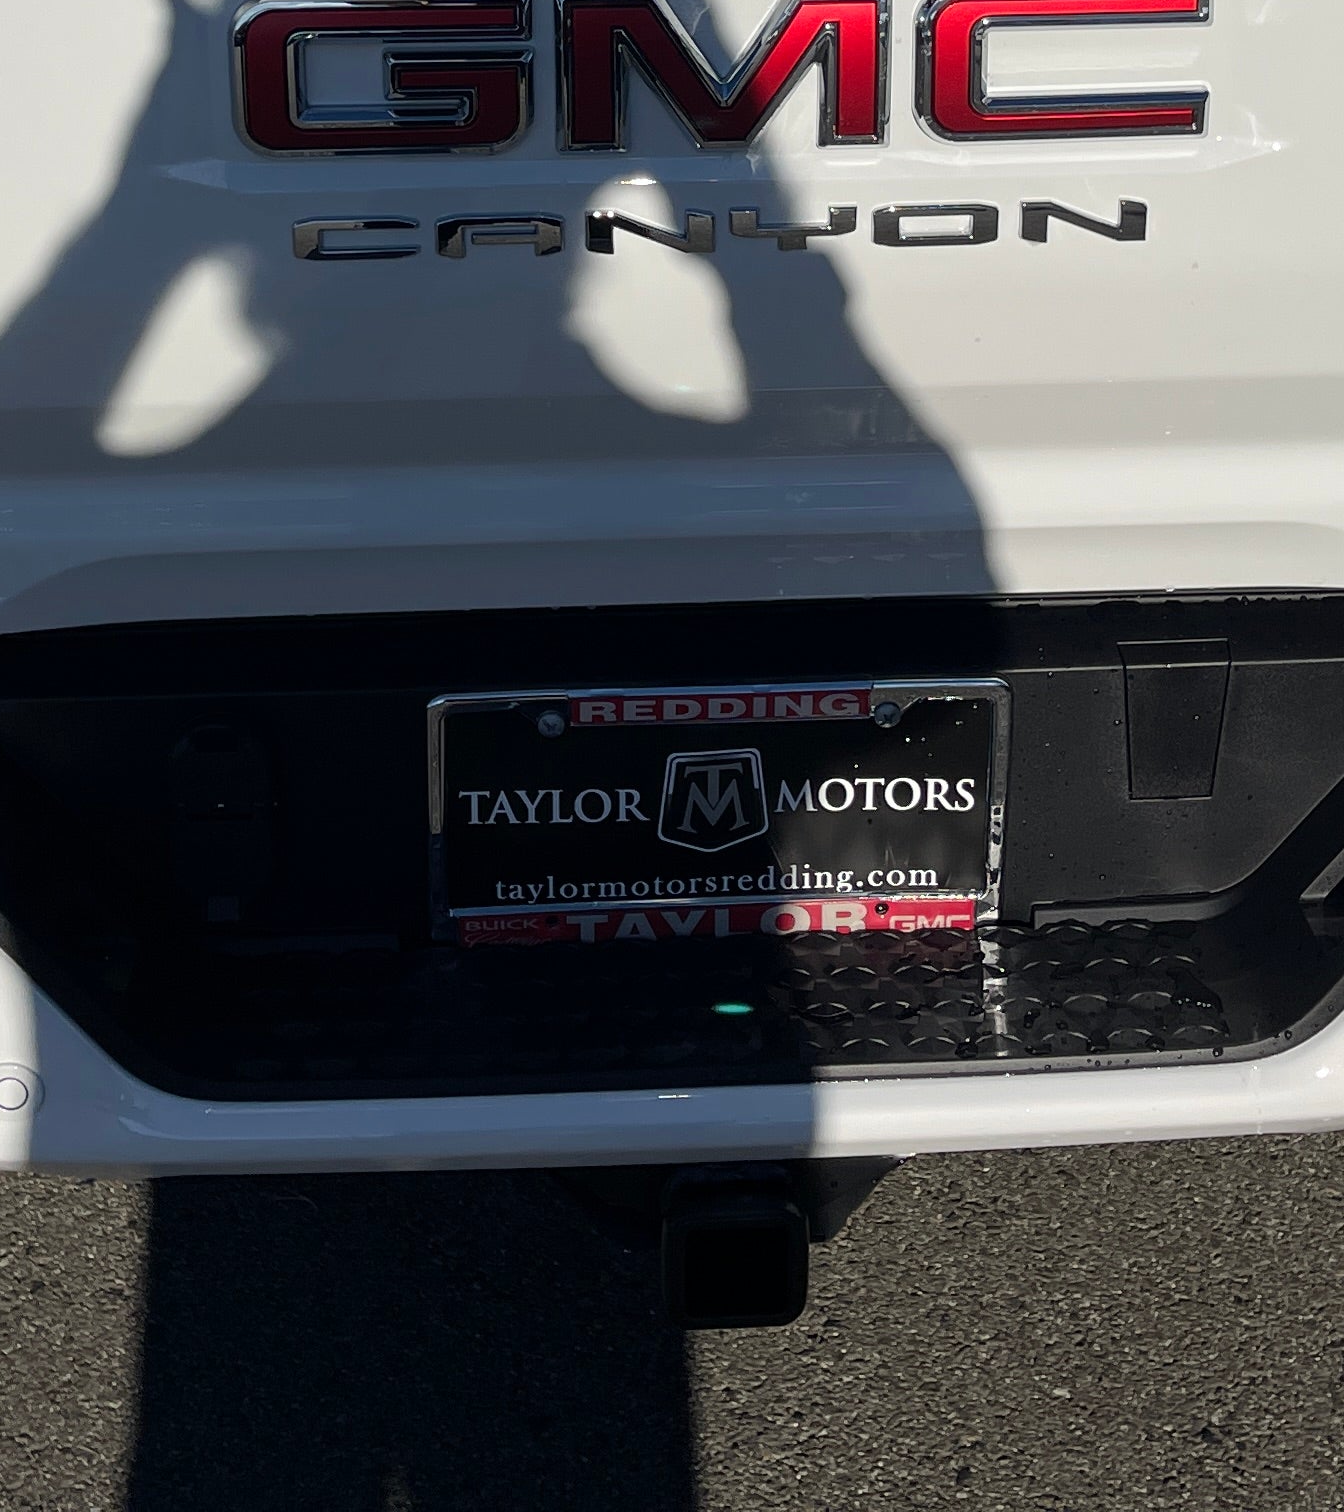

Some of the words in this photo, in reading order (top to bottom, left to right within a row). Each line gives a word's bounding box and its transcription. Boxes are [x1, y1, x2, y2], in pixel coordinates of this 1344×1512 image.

[291, 199, 1148, 259] CANYON
[578, 694, 861, 723] REDDING
[458, 787, 650, 826] TAYLOR
[775, 777, 976, 813] MOTORS
[495, 864, 939, 905] taylormotorsredding.com
[464, 918, 538, 931] BUICK
[565, 903, 868, 944] TAYLOR
[889, 915, 971, 932] GMC
